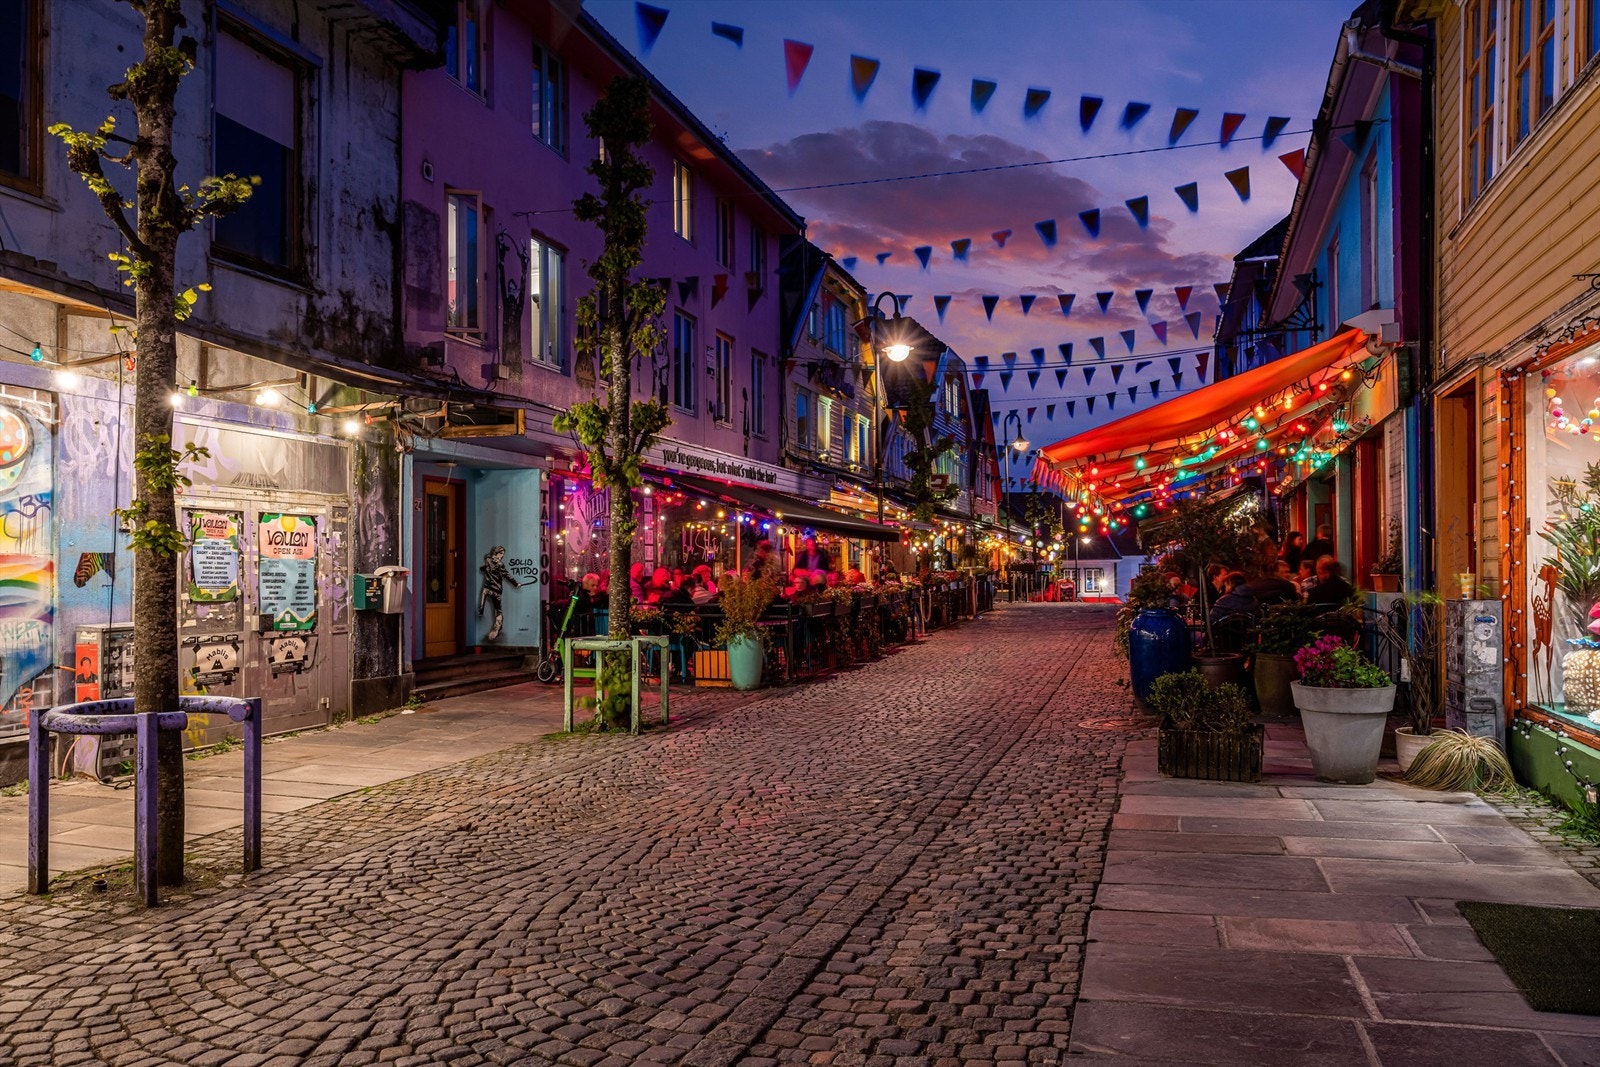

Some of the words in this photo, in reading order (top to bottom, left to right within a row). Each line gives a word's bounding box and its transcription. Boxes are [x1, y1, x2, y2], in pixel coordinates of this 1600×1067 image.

[663, 447, 686, 465] you're
[686, 455, 716, 474] gorgeous,
[717, 458, 727, 474] but
[727, 462, 745, 478] what's
[745, 466, 756, 480] with
[757, 468, 765, 482] the
[414, 500, 422, 511] 24
[540, 490, 550, 586] TATTOO
[273, 547, 291, 555] OPEN
[292, 548, 304, 556] AIR
[508, 559, 533, 567] SOLID
[510, 567, 538, 576] TATTOO
[279, 640, 299, 652] Mablis
[206, 648, 229, 662] Mablis
